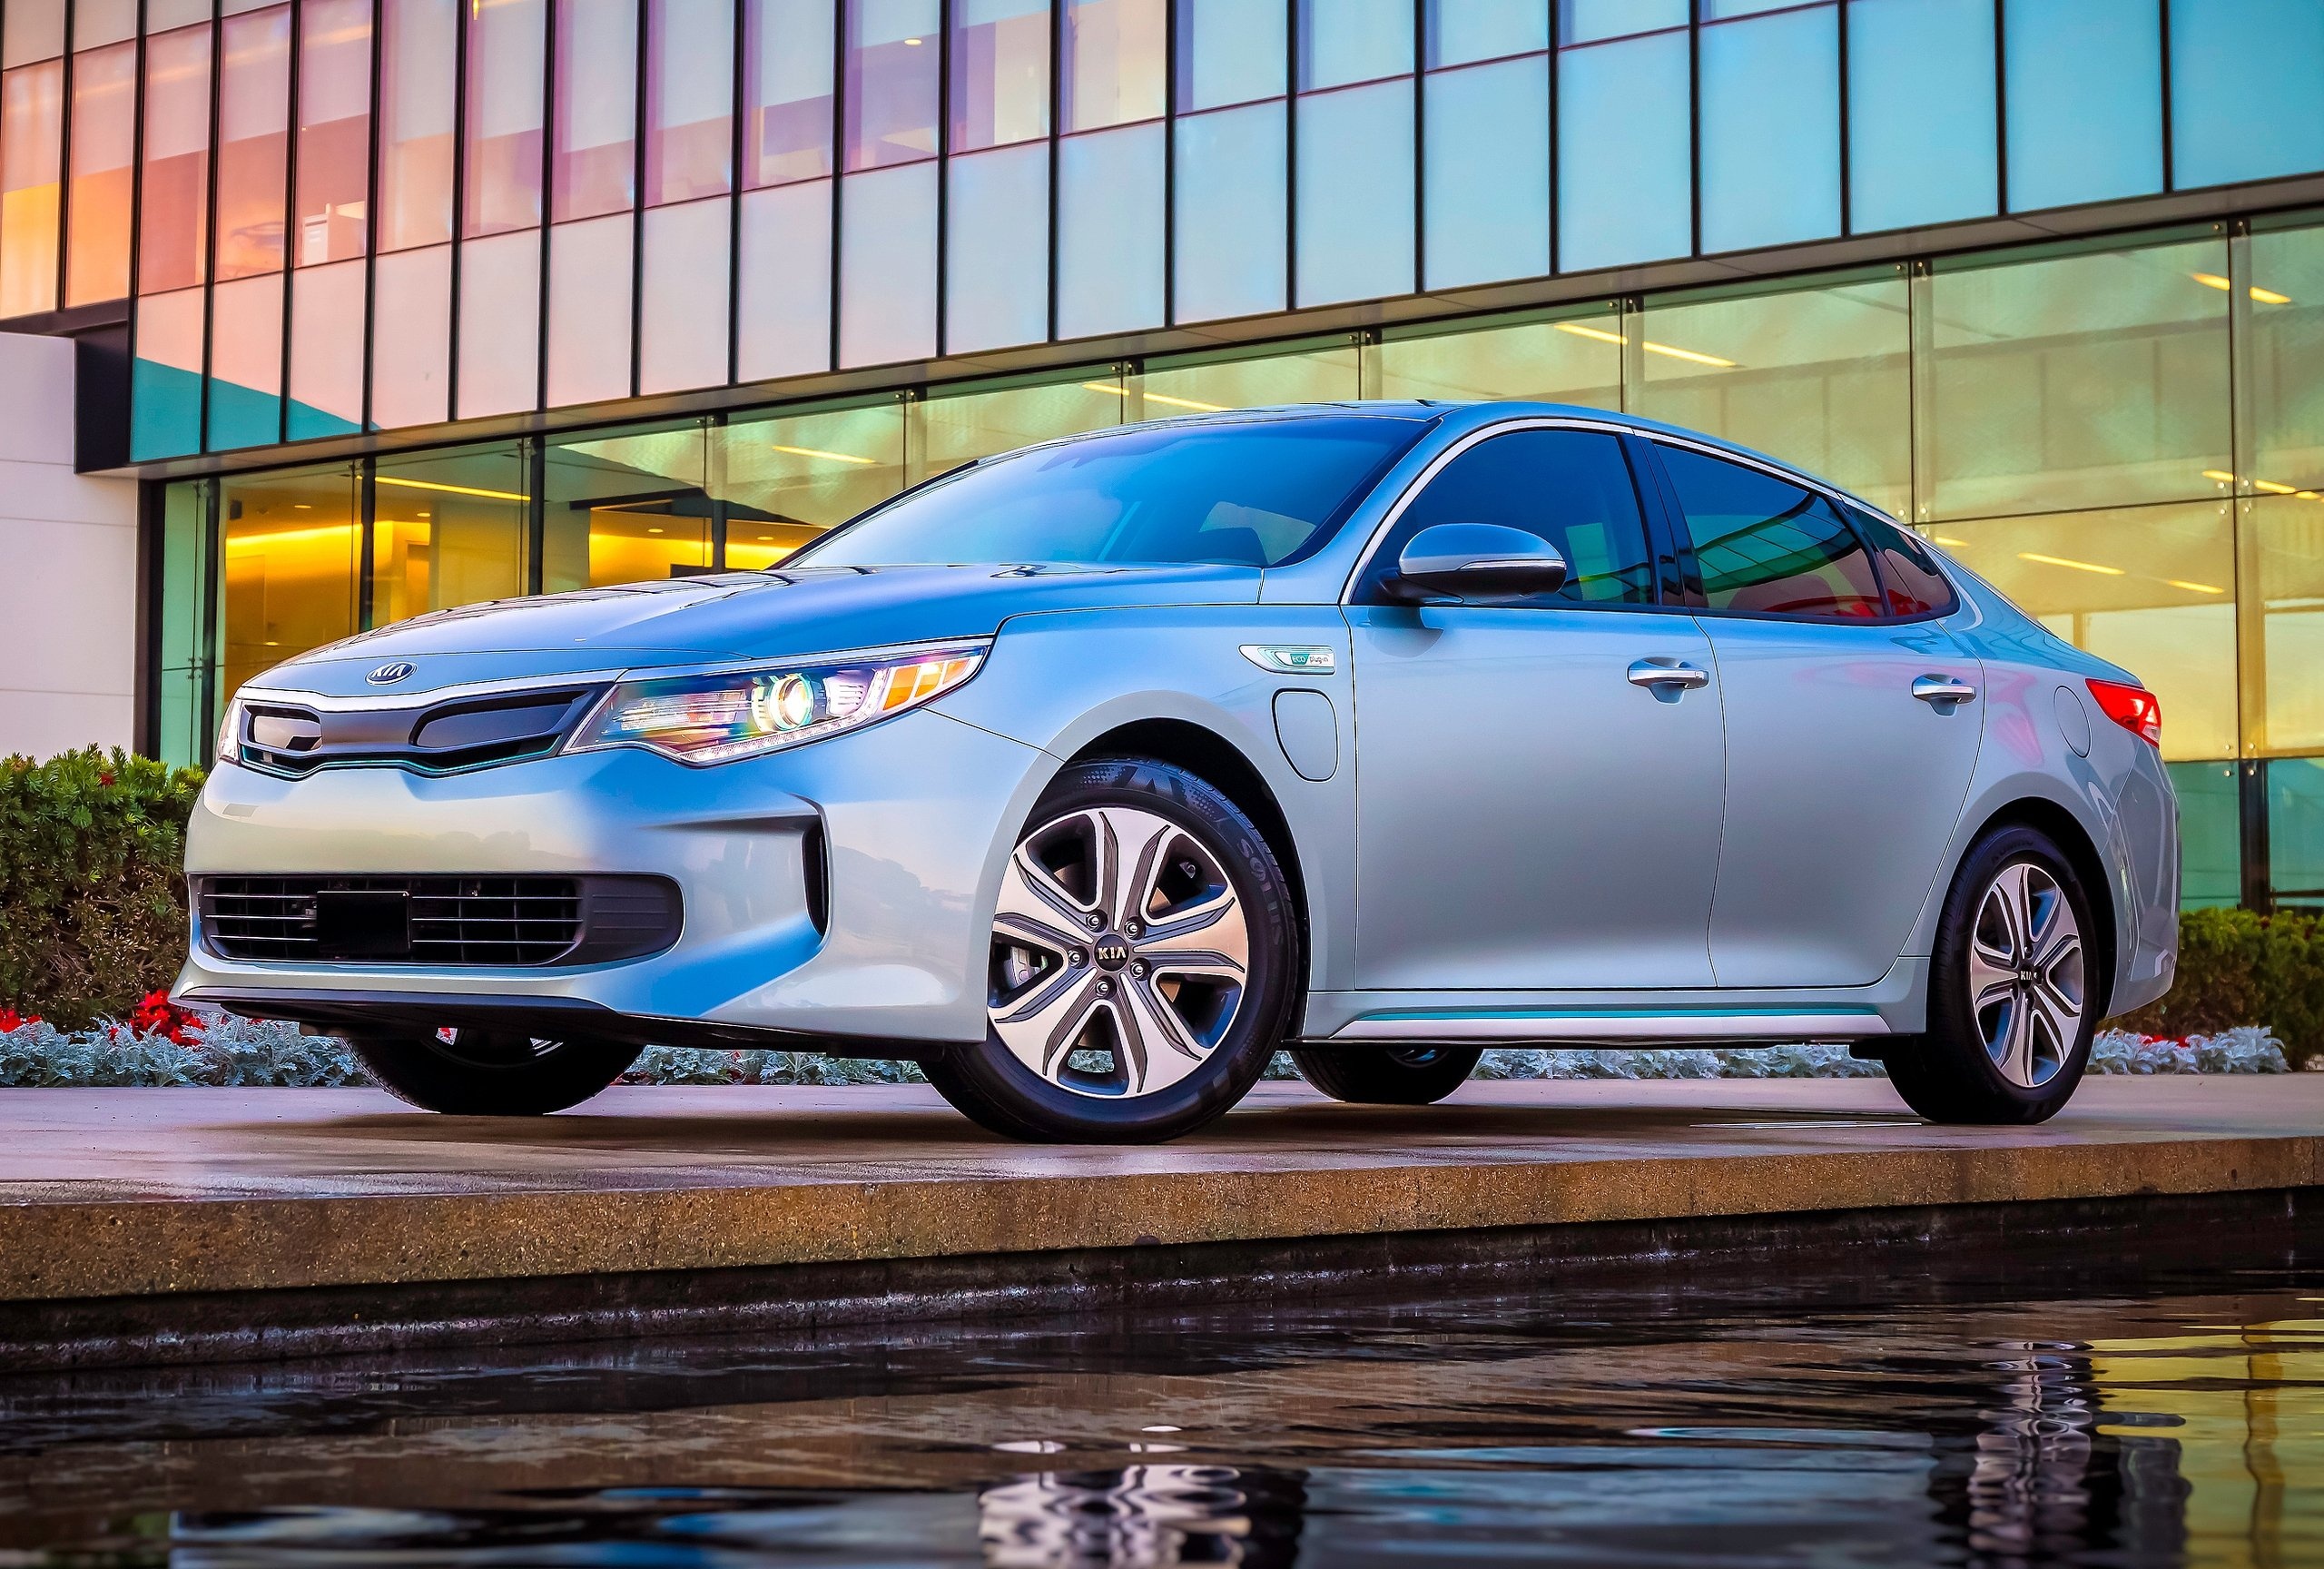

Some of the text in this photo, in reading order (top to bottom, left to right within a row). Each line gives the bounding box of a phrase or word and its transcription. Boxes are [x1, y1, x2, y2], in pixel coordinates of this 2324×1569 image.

[1293, 656, 1306, 664] ECO
[370, 663, 408, 678] KIA
[1097, 946, 1127, 960] KIA
[2020, 971, 2033, 981] KIA
